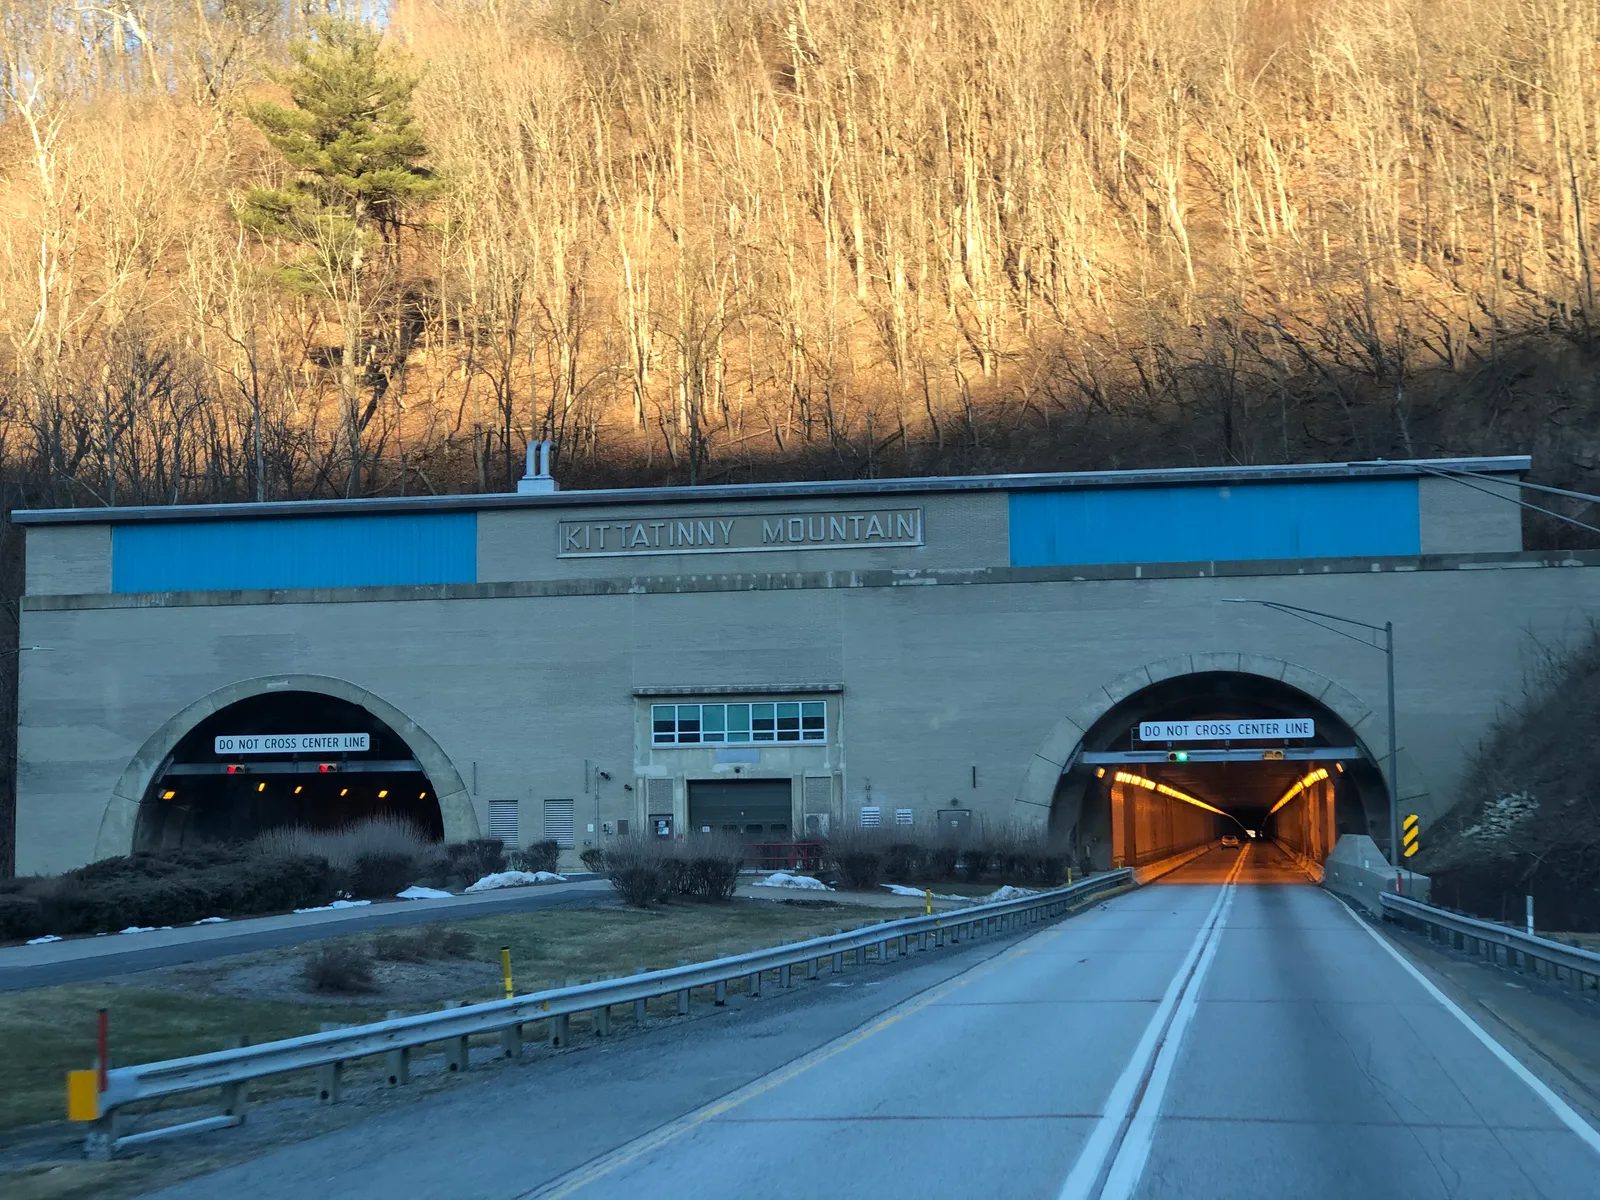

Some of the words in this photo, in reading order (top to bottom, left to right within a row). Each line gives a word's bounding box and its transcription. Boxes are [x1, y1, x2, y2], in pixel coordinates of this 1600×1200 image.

[565, 520, 735, 550] KITTATINNY
[762, 513, 915, 543] MOUNTAIN
[1144, 725, 1161, 737] DO
[1166, 725, 1190, 736] NOT
[1195, 724, 1232, 736] CROSS
[1238, 723, 1280, 735] CENTER
[1285, 722, 1309, 734] LINE
[219, 739, 234, 750] DO
[238, 739, 260, 750] NOT
[264, 738, 297, 749] CROSS
[302, 737, 339, 748] CENTER
[344, 736, 366, 748] LINE
